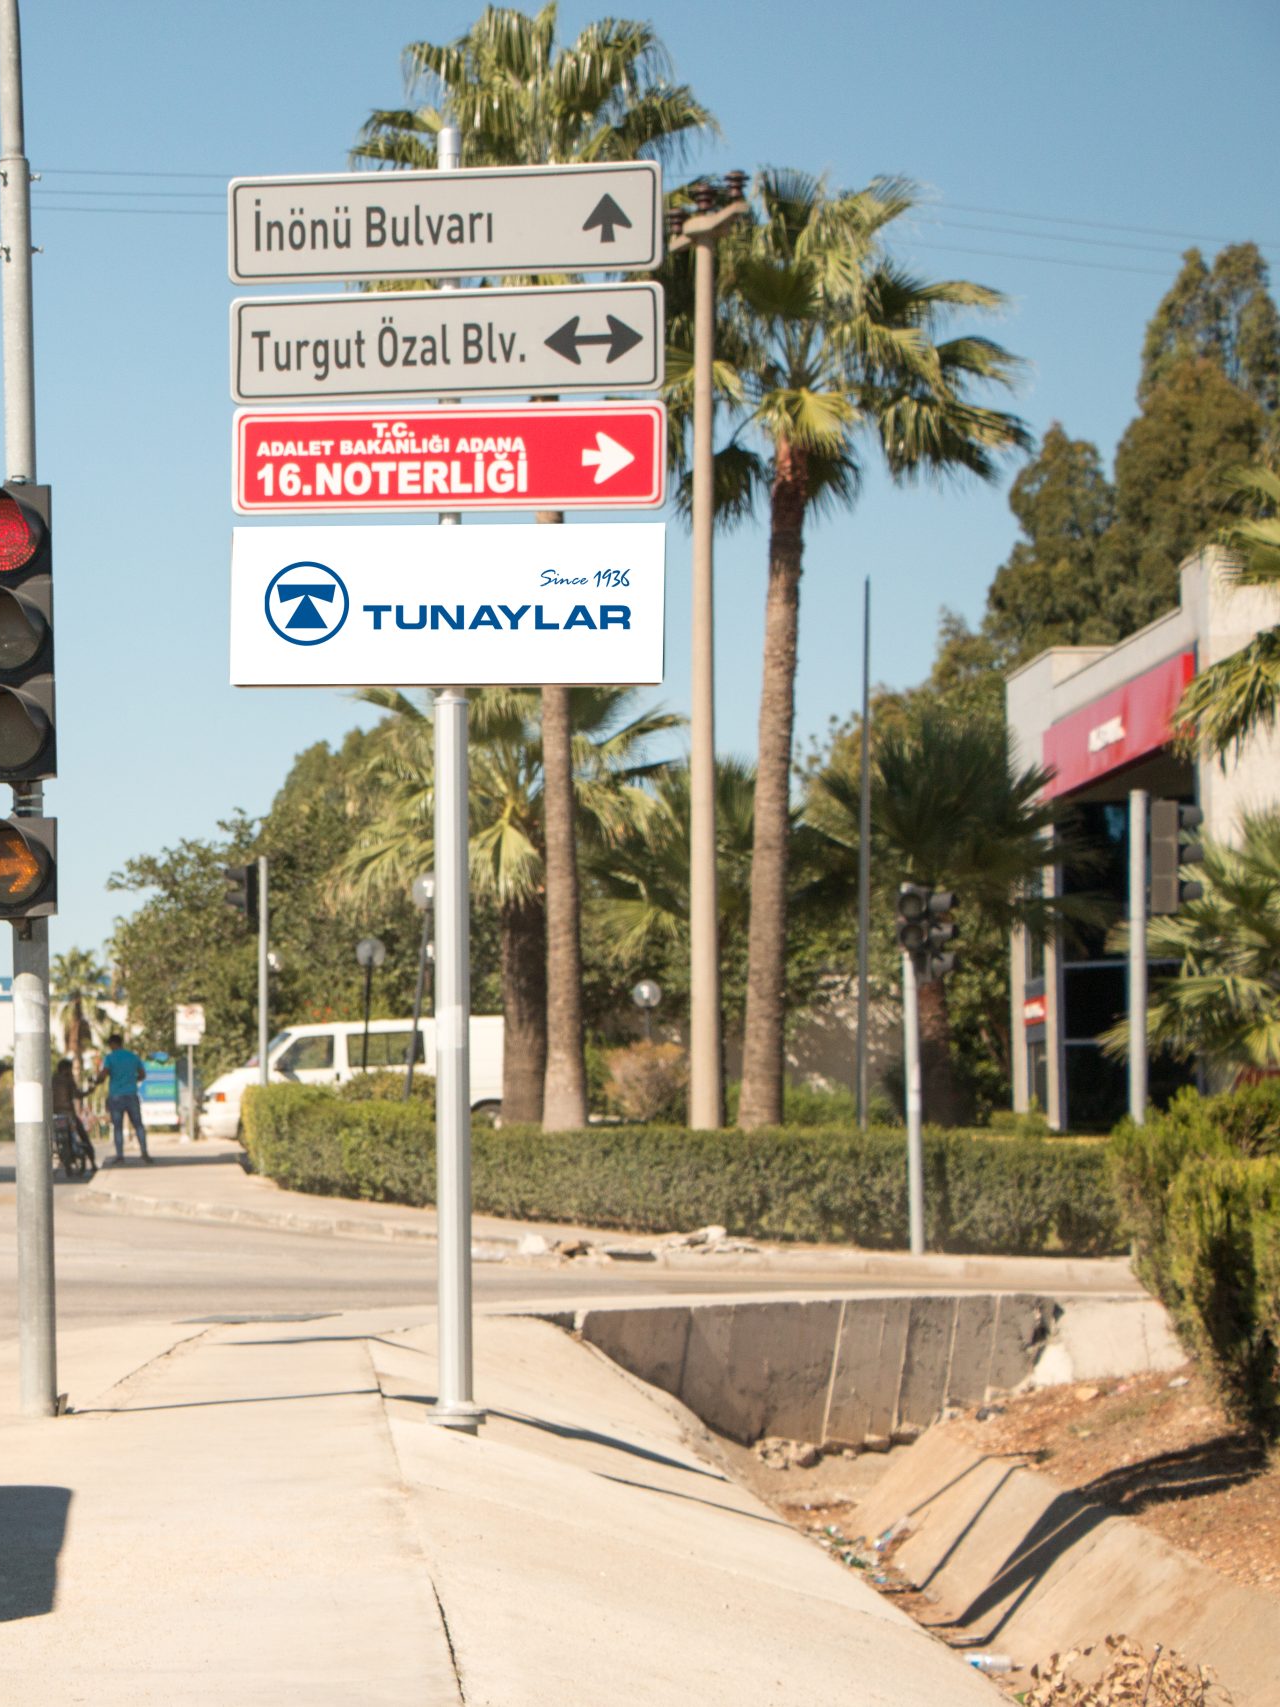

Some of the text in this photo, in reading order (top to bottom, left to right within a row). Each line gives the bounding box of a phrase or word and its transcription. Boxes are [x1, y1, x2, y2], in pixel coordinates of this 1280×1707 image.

[254, 198, 493, 252] İnönü Bulvarı
[251, 316, 526, 381] Turgut Özal Blv.
[372, 422, 415, 439] T.C.
[256, 434, 526, 457] ADALET BAKANLIĞI ADANA
[256, 452, 528, 497] 16.NOTERLİĞİ
[540, 568, 631, 588] Since 1936
[362, 604, 632, 631] TUNAYLAR
